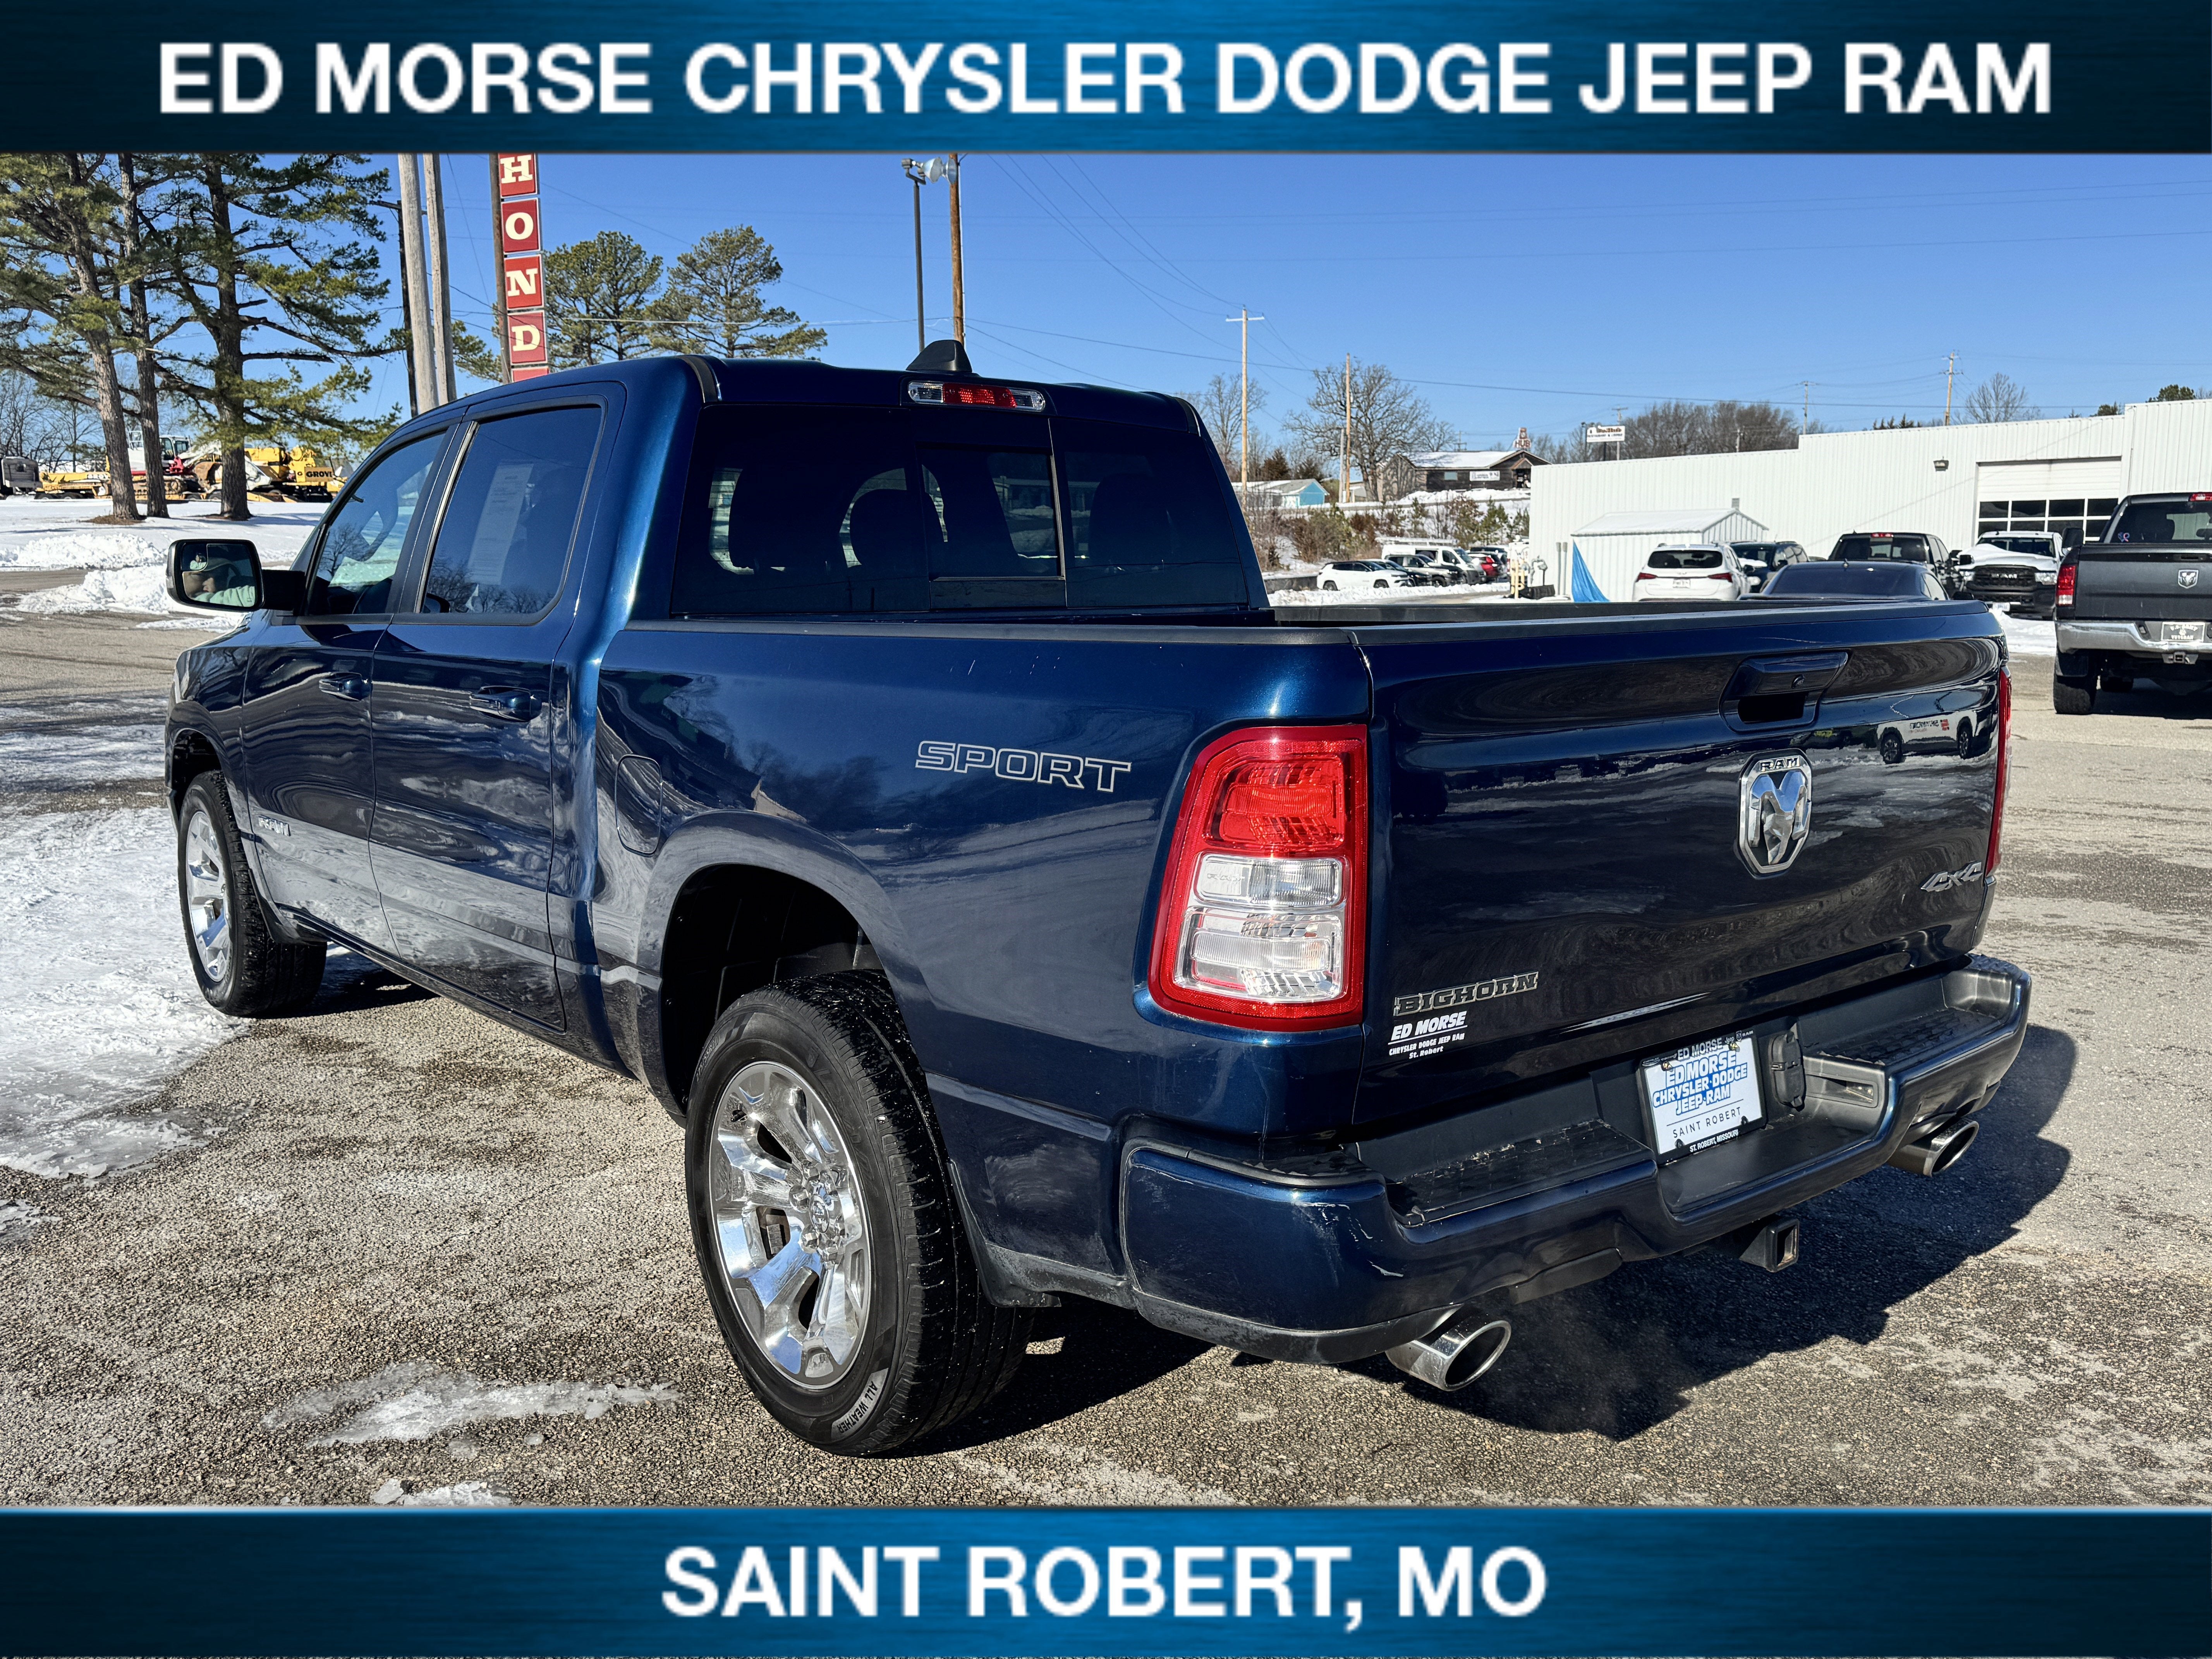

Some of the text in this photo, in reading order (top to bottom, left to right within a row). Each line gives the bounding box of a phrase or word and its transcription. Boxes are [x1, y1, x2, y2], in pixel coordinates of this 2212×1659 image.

[915, 740, 1132, 792] SPORT
[1759, 756, 1801, 772] RAM
[1393, 971, 1539, 1017] BIGHORN
[1391, 1011, 1467, 1041] ED MORSE
[1389, 1033, 1465, 1056] CHRYSLER DODGE JEEP RAM
[1420, 1046, 1444, 1056] Robert
[1678, 1048, 1690, 1060] ED
[1692, 1037, 1723, 1057] MORSE
[1666, 1051, 1736, 1087] ED MORSE
[1673, 1107, 1741, 1138] SAINT ROBERT
[1717, 1129, 1738, 1142] MISSOURI
[836, 1381, 878, 1434] ALL WEATHER
